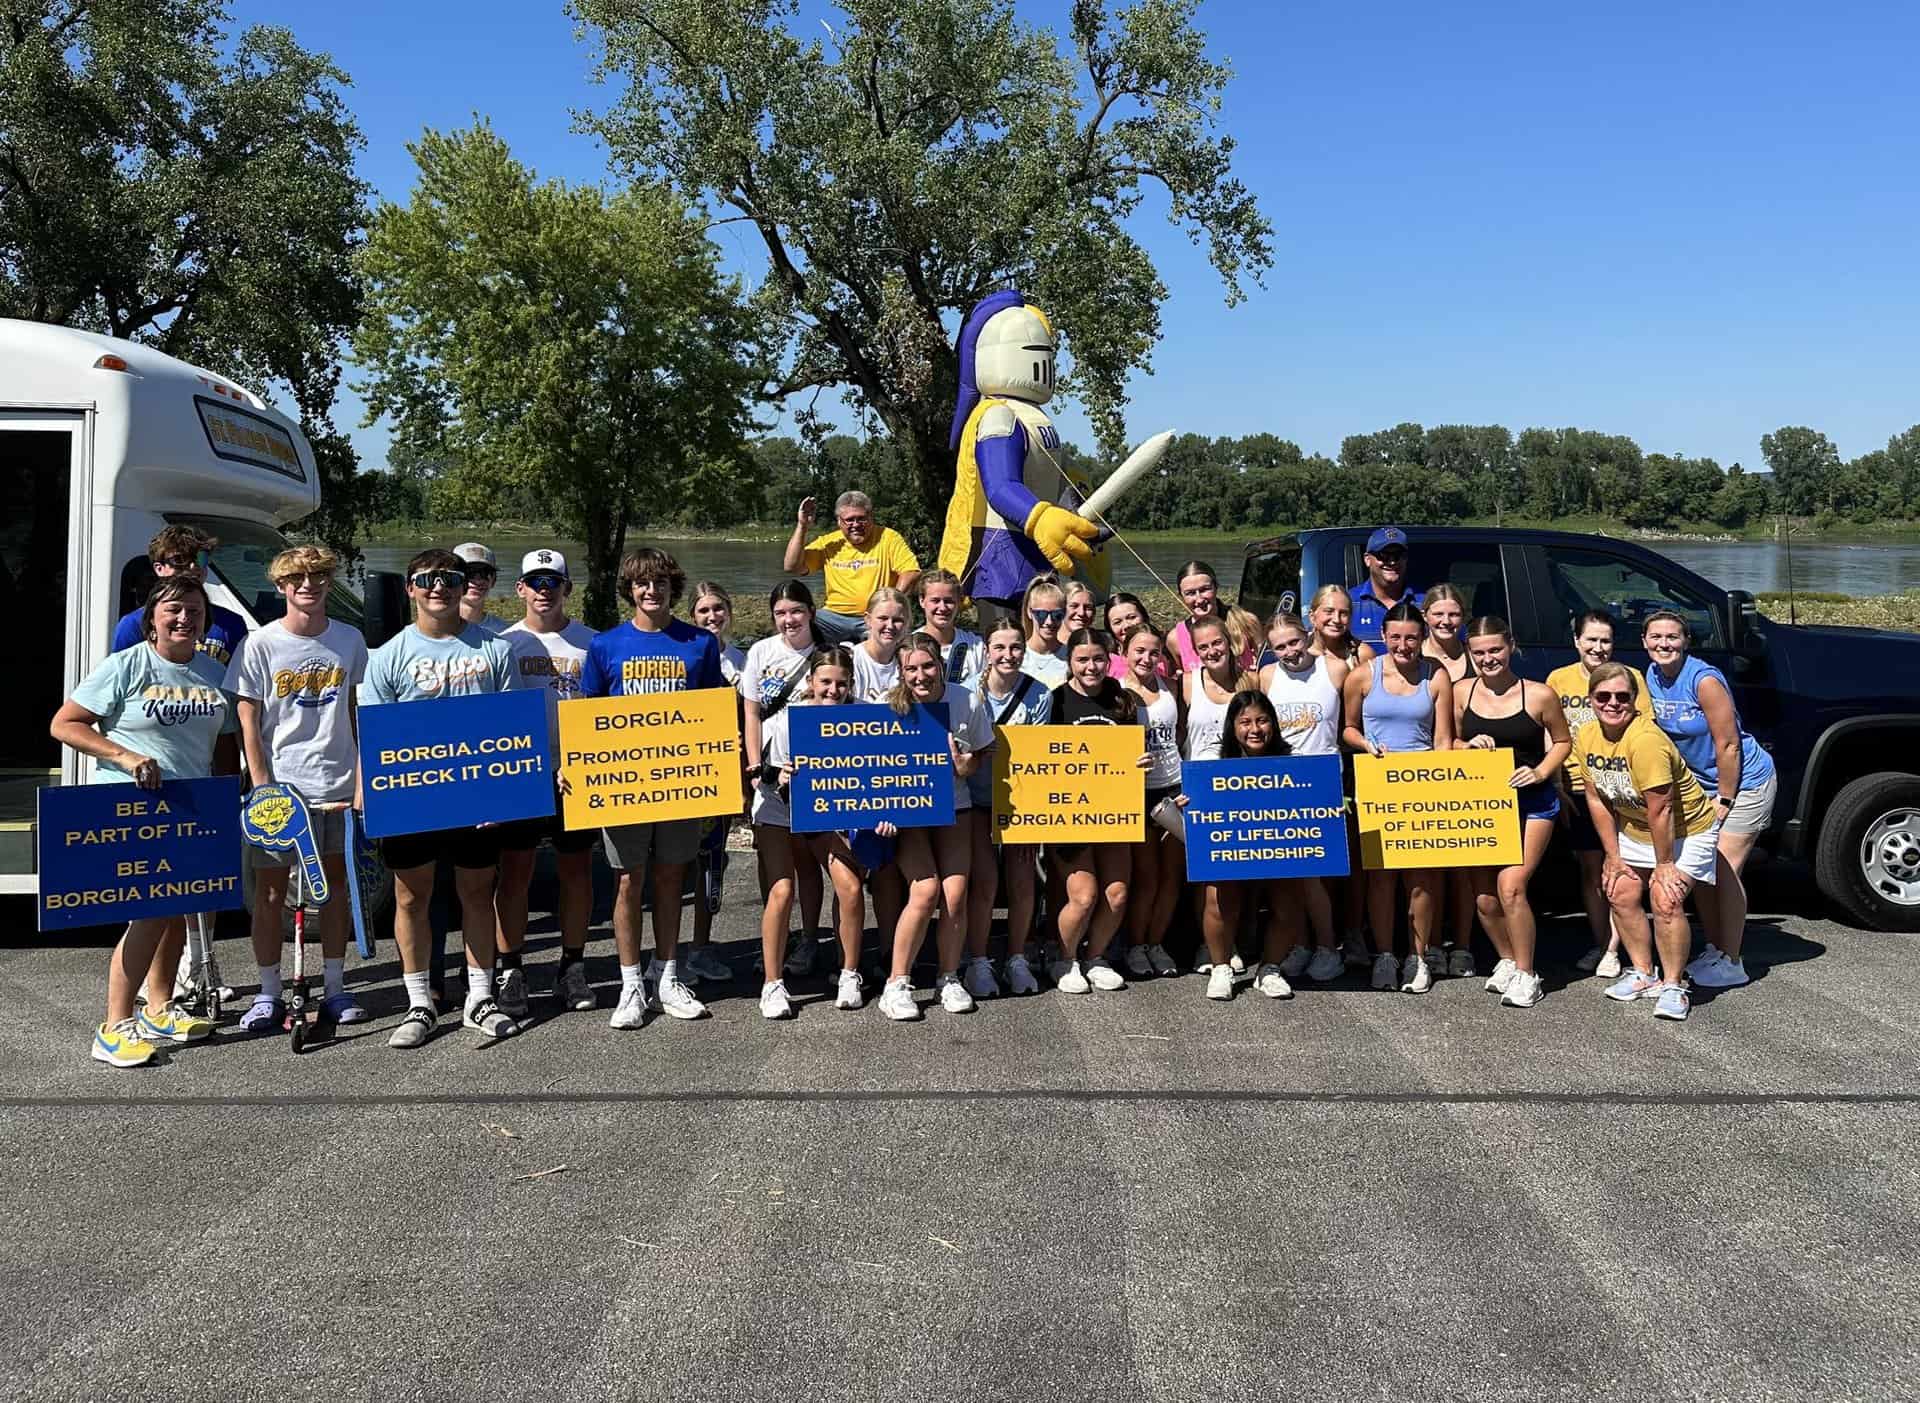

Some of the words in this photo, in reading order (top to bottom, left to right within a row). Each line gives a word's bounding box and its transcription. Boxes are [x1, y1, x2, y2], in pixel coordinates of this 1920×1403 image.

[622, 660, 687, 680] BORGIA
[622, 678, 687, 696] KNIGHTS
[142, 699, 223, 726] Knights
[595, 710, 704, 731] BORGIA...
[820, 721, 921, 737] BORGIA...
[380, 735, 532, 765] BORGIA.COM
[567, 744, 690, 766] PROMOTING
[695, 740, 735, 754] THE
[1049, 742, 1073, 754] BE
[1078, 742, 1090, 754] A
[794, 754, 907, 770] PROMOTING
[912, 753, 948, 766] THE
[1012, 763, 1061, 775] PART
[1065, 763, 1089, 775] OF
[1094, 763, 1126, 775] IT...
[371, 768, 455, 791] CHECK
[461, 764, 482, 781] IT
[488, 755, 543, 777] OUT!
[585, 771, 644, 788] MIND,
[650, 763, 719, 781] SPIRIT,
[1386, 768, 1485, 783] BORGIA...
[811, 776, 865, 791] MIND,
[871, 774, 934, 789] SPIRIT,
[1212, 774, 1312, 791] BORGIA...
[589, 794, 605, 808] &
[610, 785, 718, 806] TRADITION
[813, 797, 829, 813] &
[833, 795, 933, 811] TRADITION
[1049, 793, 1072, 804] BE
[1078, 793, 1090, 804] A
[116, 801, 148, 817] BE
[155, 799, 171, 814] A
[1363, 802, 1397, 814] THE
[1402, 799, 1513, 813] FOUNDATION
[998, 814, 1066, 826] BORGIA
[1072, 813, 1140, 825] KNIGHT
[1188, 810, 1224, 824] THE
[1229, 807, 1340, 822] FOUNDATION
[1384, 821, 1407, 832] OF
[1412, 818, 1494, 831] LIFELONG
[65, 827, 132, 846] PART
[138, 824, 170, 840] OF
[176, 822, 217, 837] IT...
[1210, 830, 1233, 842] OF
[1238, 827, 1322, 841] LIFELONG
[1385, 837, 1497, 850] FRIENDSHIPS
[1211, 847, 1325, 862] FRIENDSHIPS
[117, 861, 149, 876] BE
[156, 858, 172, 872] A
[46, 886, 142, 909] BORGIA
[150, 876, 238, 898] KNIGHT
